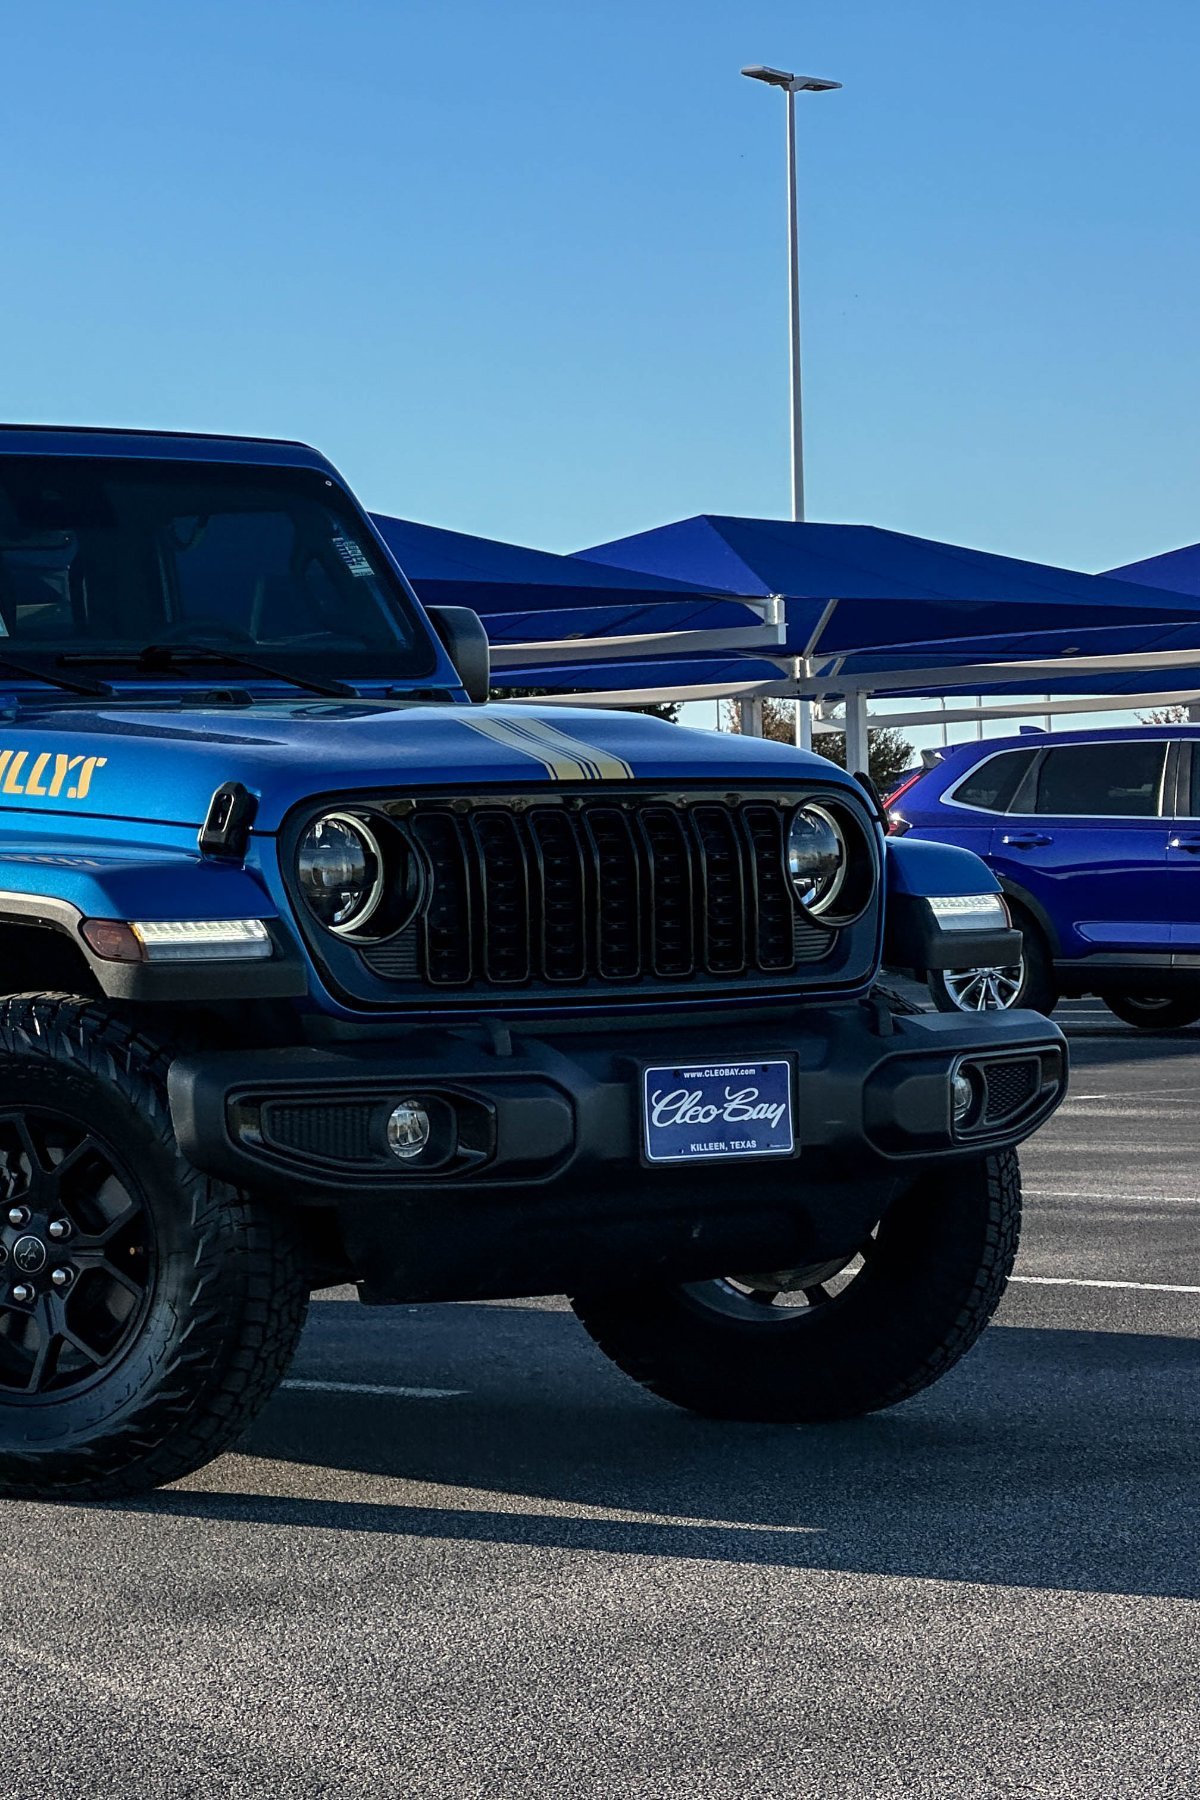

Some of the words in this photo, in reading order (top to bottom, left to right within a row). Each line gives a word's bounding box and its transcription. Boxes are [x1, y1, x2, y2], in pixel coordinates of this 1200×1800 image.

[683, 1067, 756, 1079] www.CLEOBAY.com
[651, 1089, 722, 1128] Cleo
[722, 1086, 786, 1129] Bay
[690, 1141, 728, 1152] KILLEEN,
[730, 1140, 757, 1150] TEXAS
